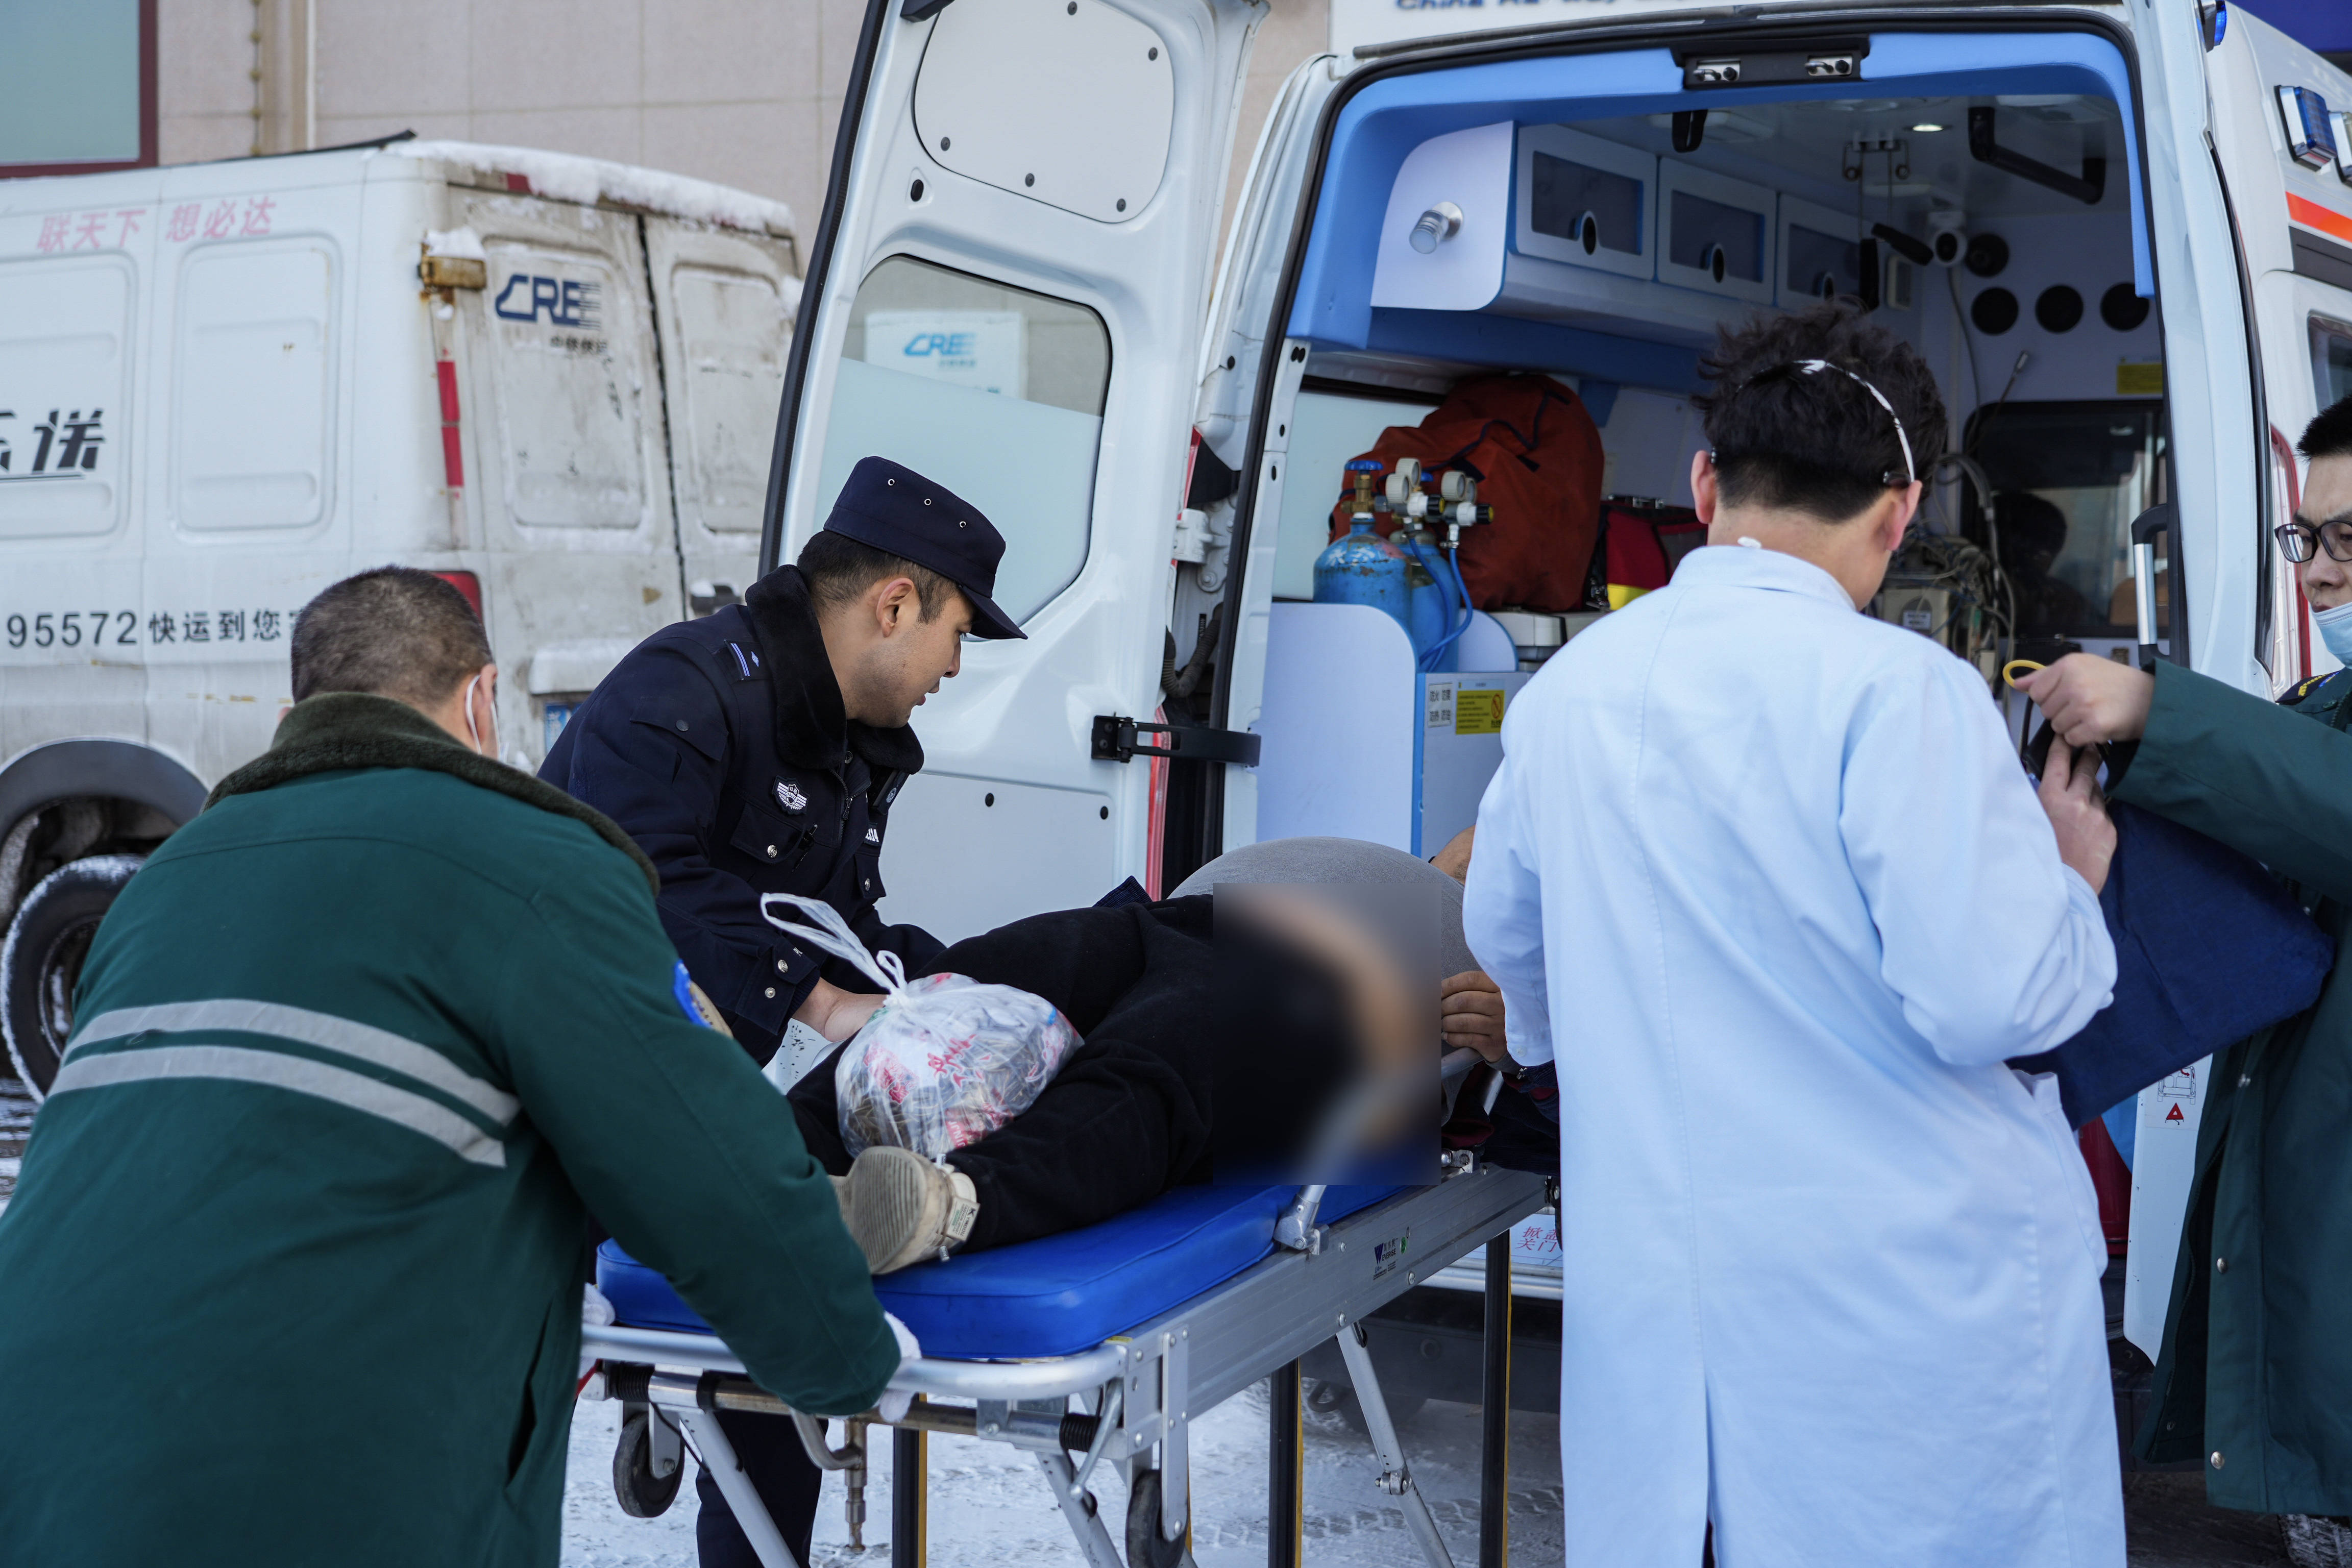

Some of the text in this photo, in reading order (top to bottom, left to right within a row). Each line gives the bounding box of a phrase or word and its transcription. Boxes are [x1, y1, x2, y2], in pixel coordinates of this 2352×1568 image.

[165, 195, 276, 242] 想必达
[495, 274, 601, 331] CRE
[904, 333, 975, 356] CRE
[7, 608, 302, 648] 95572 快运到您
[1522, 1226, 1558, 1241] 掀盖
[1382, 1248, 1396, 1261] EVERISE
[1515, 1238, 1557, 1253] 关门
